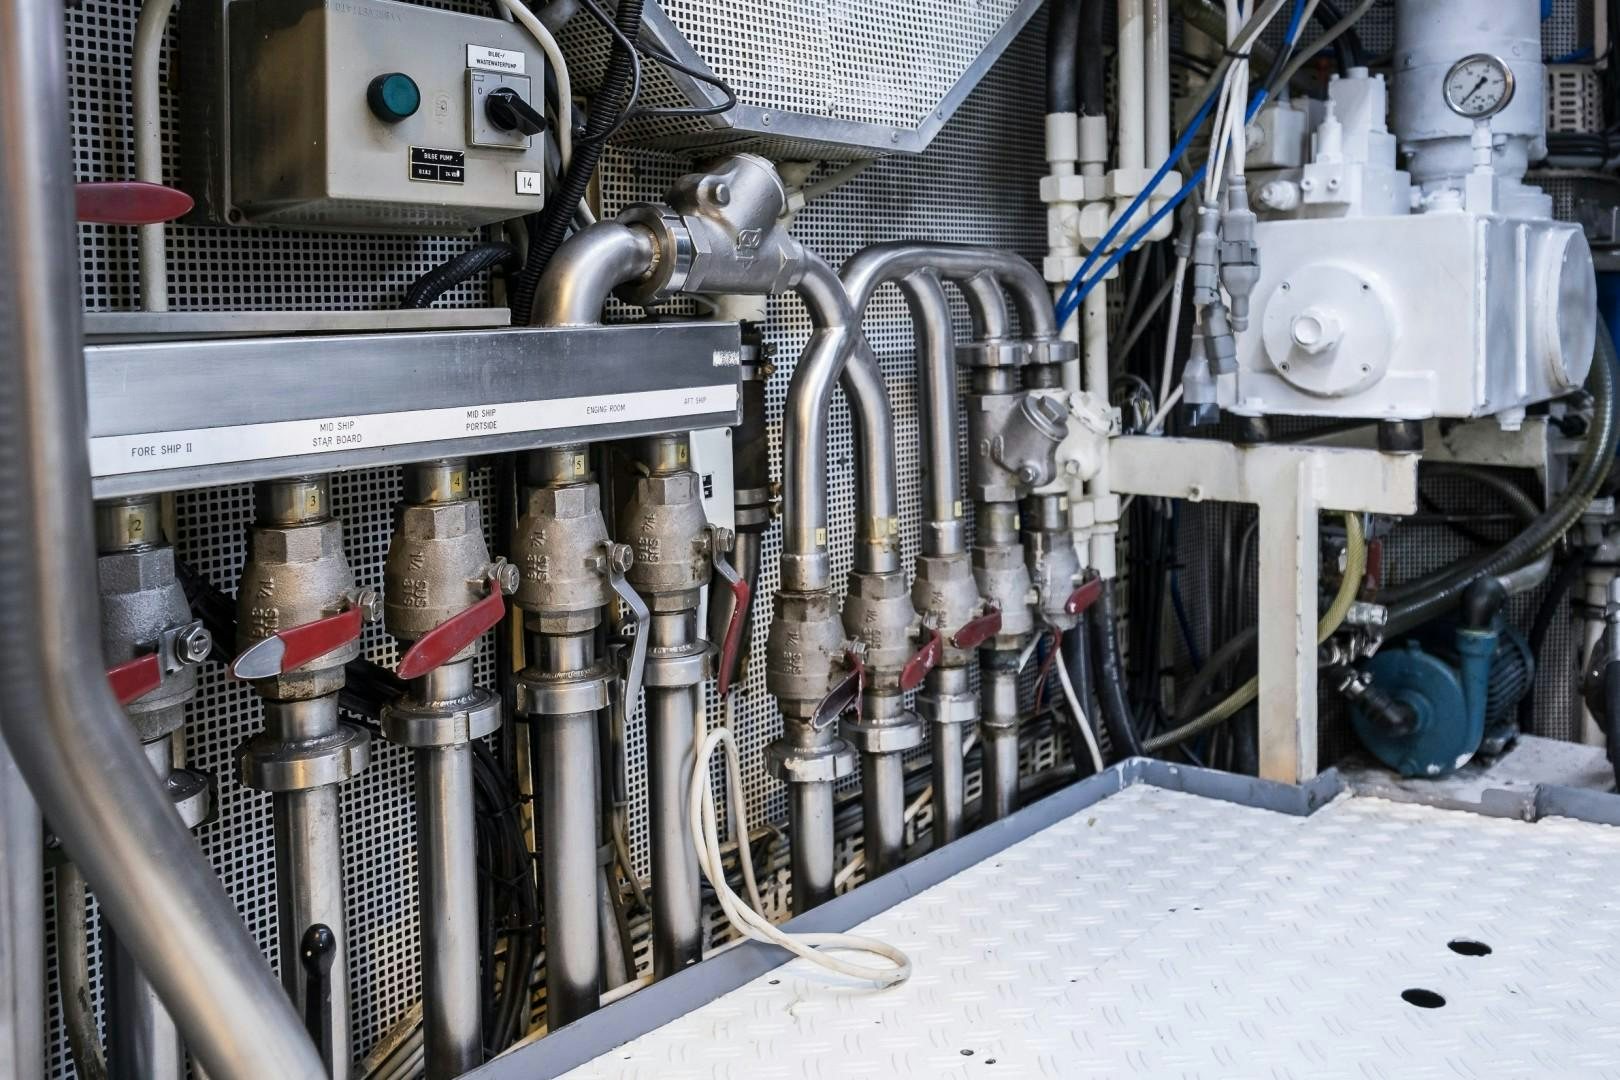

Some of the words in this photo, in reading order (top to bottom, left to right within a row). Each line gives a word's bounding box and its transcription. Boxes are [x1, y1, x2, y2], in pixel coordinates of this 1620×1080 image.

[424, 152, 438, 160] BILGE
[523, 176, 532, 189] 14
[466, 409, 479, 418] MID
[481, 408, 497, 418] SHIP
[609, 403, 626, 413] ROOM
[319, 422, 334, 432] MID
[337, 420, 355, 431] SHIP
[465, 420, 497, 431] PORTSIDE
[312, 436, 333, 448] STAR
[336, 433, 362, 445] BOARD
[131, 446, 157, 457] FORE
[161, 443, 182, 455] SHIP
[680, 448, 686, 459] 6
[576, 460, 582, 470] 5
[454, 475, 460, 487] 4
[310, 495, 316, 507] 3
[134, 519, 142, 531] 2
